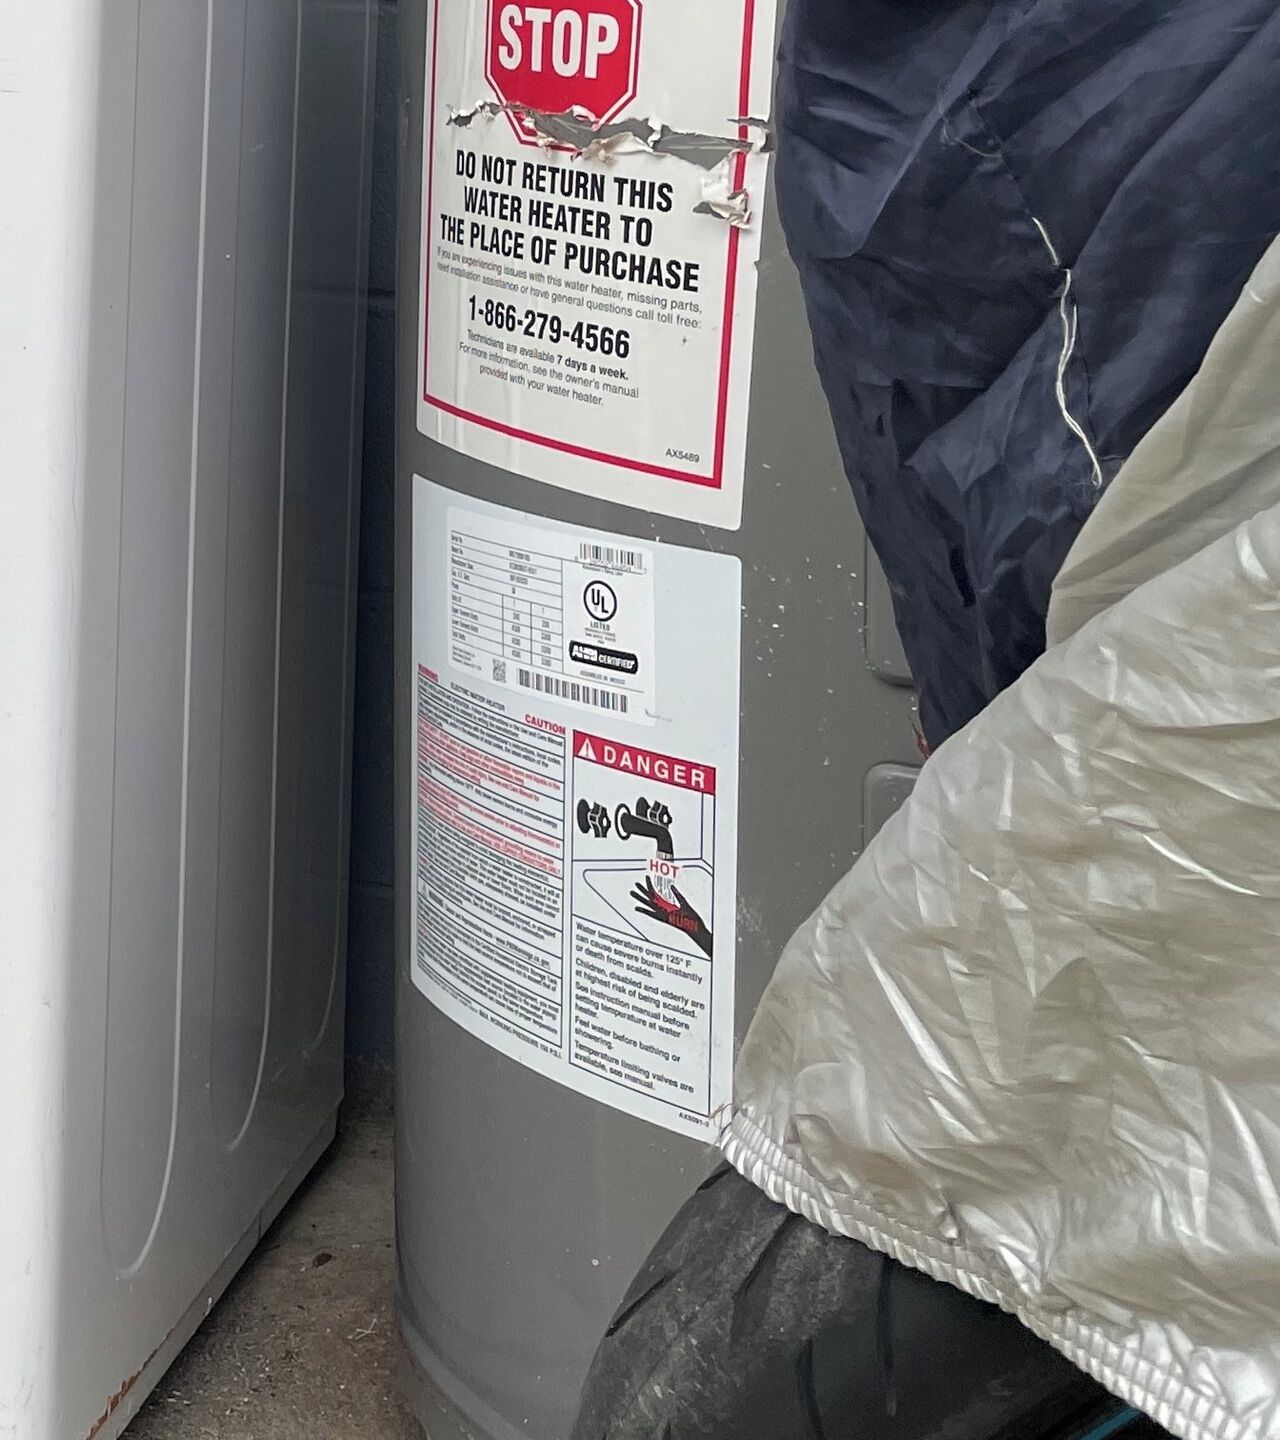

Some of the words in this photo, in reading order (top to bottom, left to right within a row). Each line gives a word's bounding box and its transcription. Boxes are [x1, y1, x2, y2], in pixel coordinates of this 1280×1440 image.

[498, 3, 620, 79] STOP
[456, 149, 476, 179] DO
[481, 154, 517, 186] NOT
[522, 162, 606, 203] RETURN
[614, 177, 674, 213] THIS
[464, 185, 522, 224] WATER
[528, 199, 611, 240] HEATER
[620, 214, 653, 247] TO
[440, 213, 464, 245] THE
[470, 222, 524, 260] PLACE
[530, 235, 557, 265] OF
[564, 242, 699, 292] PURCHASE
[461, 256, 502, 275] experiencing
[504, 263, 527, 279] issues
[529, 270, 545, 283] with
[547, 275, 562, 287] this
[564, 280, 589, 293] water
[591, 284, 623, 300] heater,
[627, 292, 667, 309] missing
[670, 299, 703, 314] parts,
[482, 275, 519, 292] assistance
[520, 285, 529, 294] or
[530, 286, 550, 299] have
[552, 292, 584, 307] general
[586, 300, 633, 317] questions
[635, 309, 654, 321] call
[656, 312, 673, 324] toll
[676, 316, 702, 329] free:
[469, 294, 630, 358] 1-866-279-4566
[459, 341, 470, 353] For
[471, 347, 488, 359] more
[489, 352, 531, 374] information,
[532, 364, 548, 376] see
[550, 367, 563, 380] the
[565, 374, 600, 390] owner's
[602, 381, 640, 399] manual
[466, 328, 504, 350] Technicians
[506, 341, 518, 354] are
[519, 347, 555, 363] available
[556, 354, 563, 365] 7
[564, 356, 588, 372] days
[590, 363, 597, 373] a
[599, 366, 629, 380] week.
[479, 364, 508, 381] provided
[509, 372, 526, 385] with
[527, 379, 546, 391] your
[546, 384, 570, 398] water
[572, 389, 604, 406] heater.
[591, 588, 609, 614] UL
[525, 714, 566, 735] CAUTION
[604, 745, 705, 789] DANGER
[650, 859, 679, 878] HOT
[576, 922, 596, 935] Water
[598, 930, 644, 953] temperature
[645, 947, 663, 959] over
[686, 960, 692, 968] F
[668, 912, 698, 932] BURN
[576, 934, 589, 944] can
[590, 939, 612, 953] cause
[614, 947, 639, 963] severe
[641, 956, 665, 971] burns
[666, 963, 703, 985] instantly
[576, 957, 608, 977] Children,
[609, 971, 642, 989] disabled
[644, 984, 659, 995] and
[661, 989, 689, 1007] elderly
[691, 1000, 705, 1010] are
[585, 947, 605, 960] death
[607, 955, 625, 968] from
[626, 963, 654, 979] scalds.
[575, 981, 589, 993] See
[590, 987, 630, 1009] instruction
[631, 1004, 661, 1020] manual
[662, 1014, 690, 1030] before
[575, 994, 599, 1010] setting
[601, 1002, 647, 1026] temperature
[648, 1021, 656, 1030] at
[658, 1025, 681, 1038] water
[584, 972, 611, 989] highest
[612, 982, 627, 995] risk
[628, 989, 637, 997] of
[638, 992, 660, 1008] being
[662, 1002, 697, 1019] scalded.
[575, 1027, 614, 1050] showering.
[591, 1023, 611, 1036] water
[612, 1031, 638, 1047] before
[639, 1040, 670, 1061] bathing
[671, 1054, 681, 1062] or
[575, 1040, 620, 1065] Temperature
[621, 1059, 650, 1079] limiting
[652, 1072, 678, 1088] valves
[680, 1083, 694, 1093] are
[575, 1052, 608, 1072] available,
[609, 1067, 623, 1078] see
[624, 1073, 656, 1091] manual.
